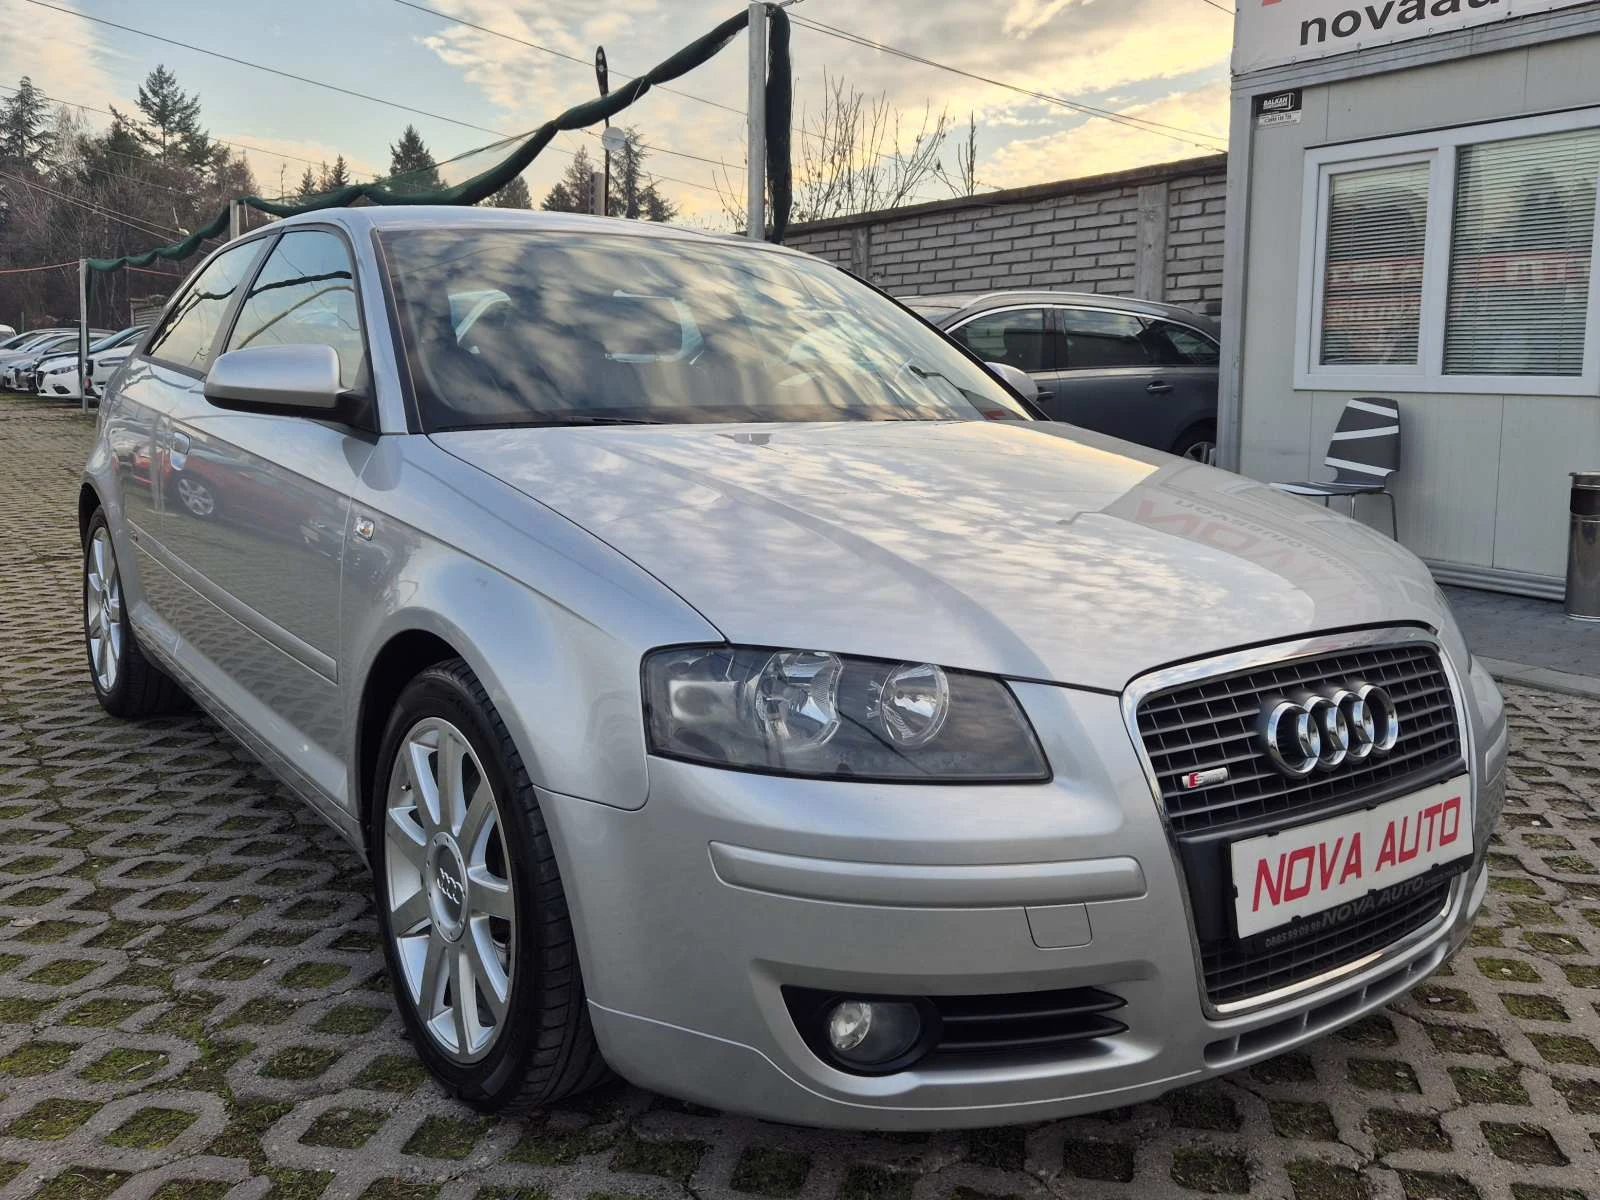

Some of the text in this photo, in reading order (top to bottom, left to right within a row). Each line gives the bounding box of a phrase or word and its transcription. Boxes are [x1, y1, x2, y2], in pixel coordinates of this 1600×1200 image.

[1252, 797, 1461, 913] NOVA AUTO
[1321, 891, 1375, 927] NOVA
[1378, 876, 1425, 906] AUTO
